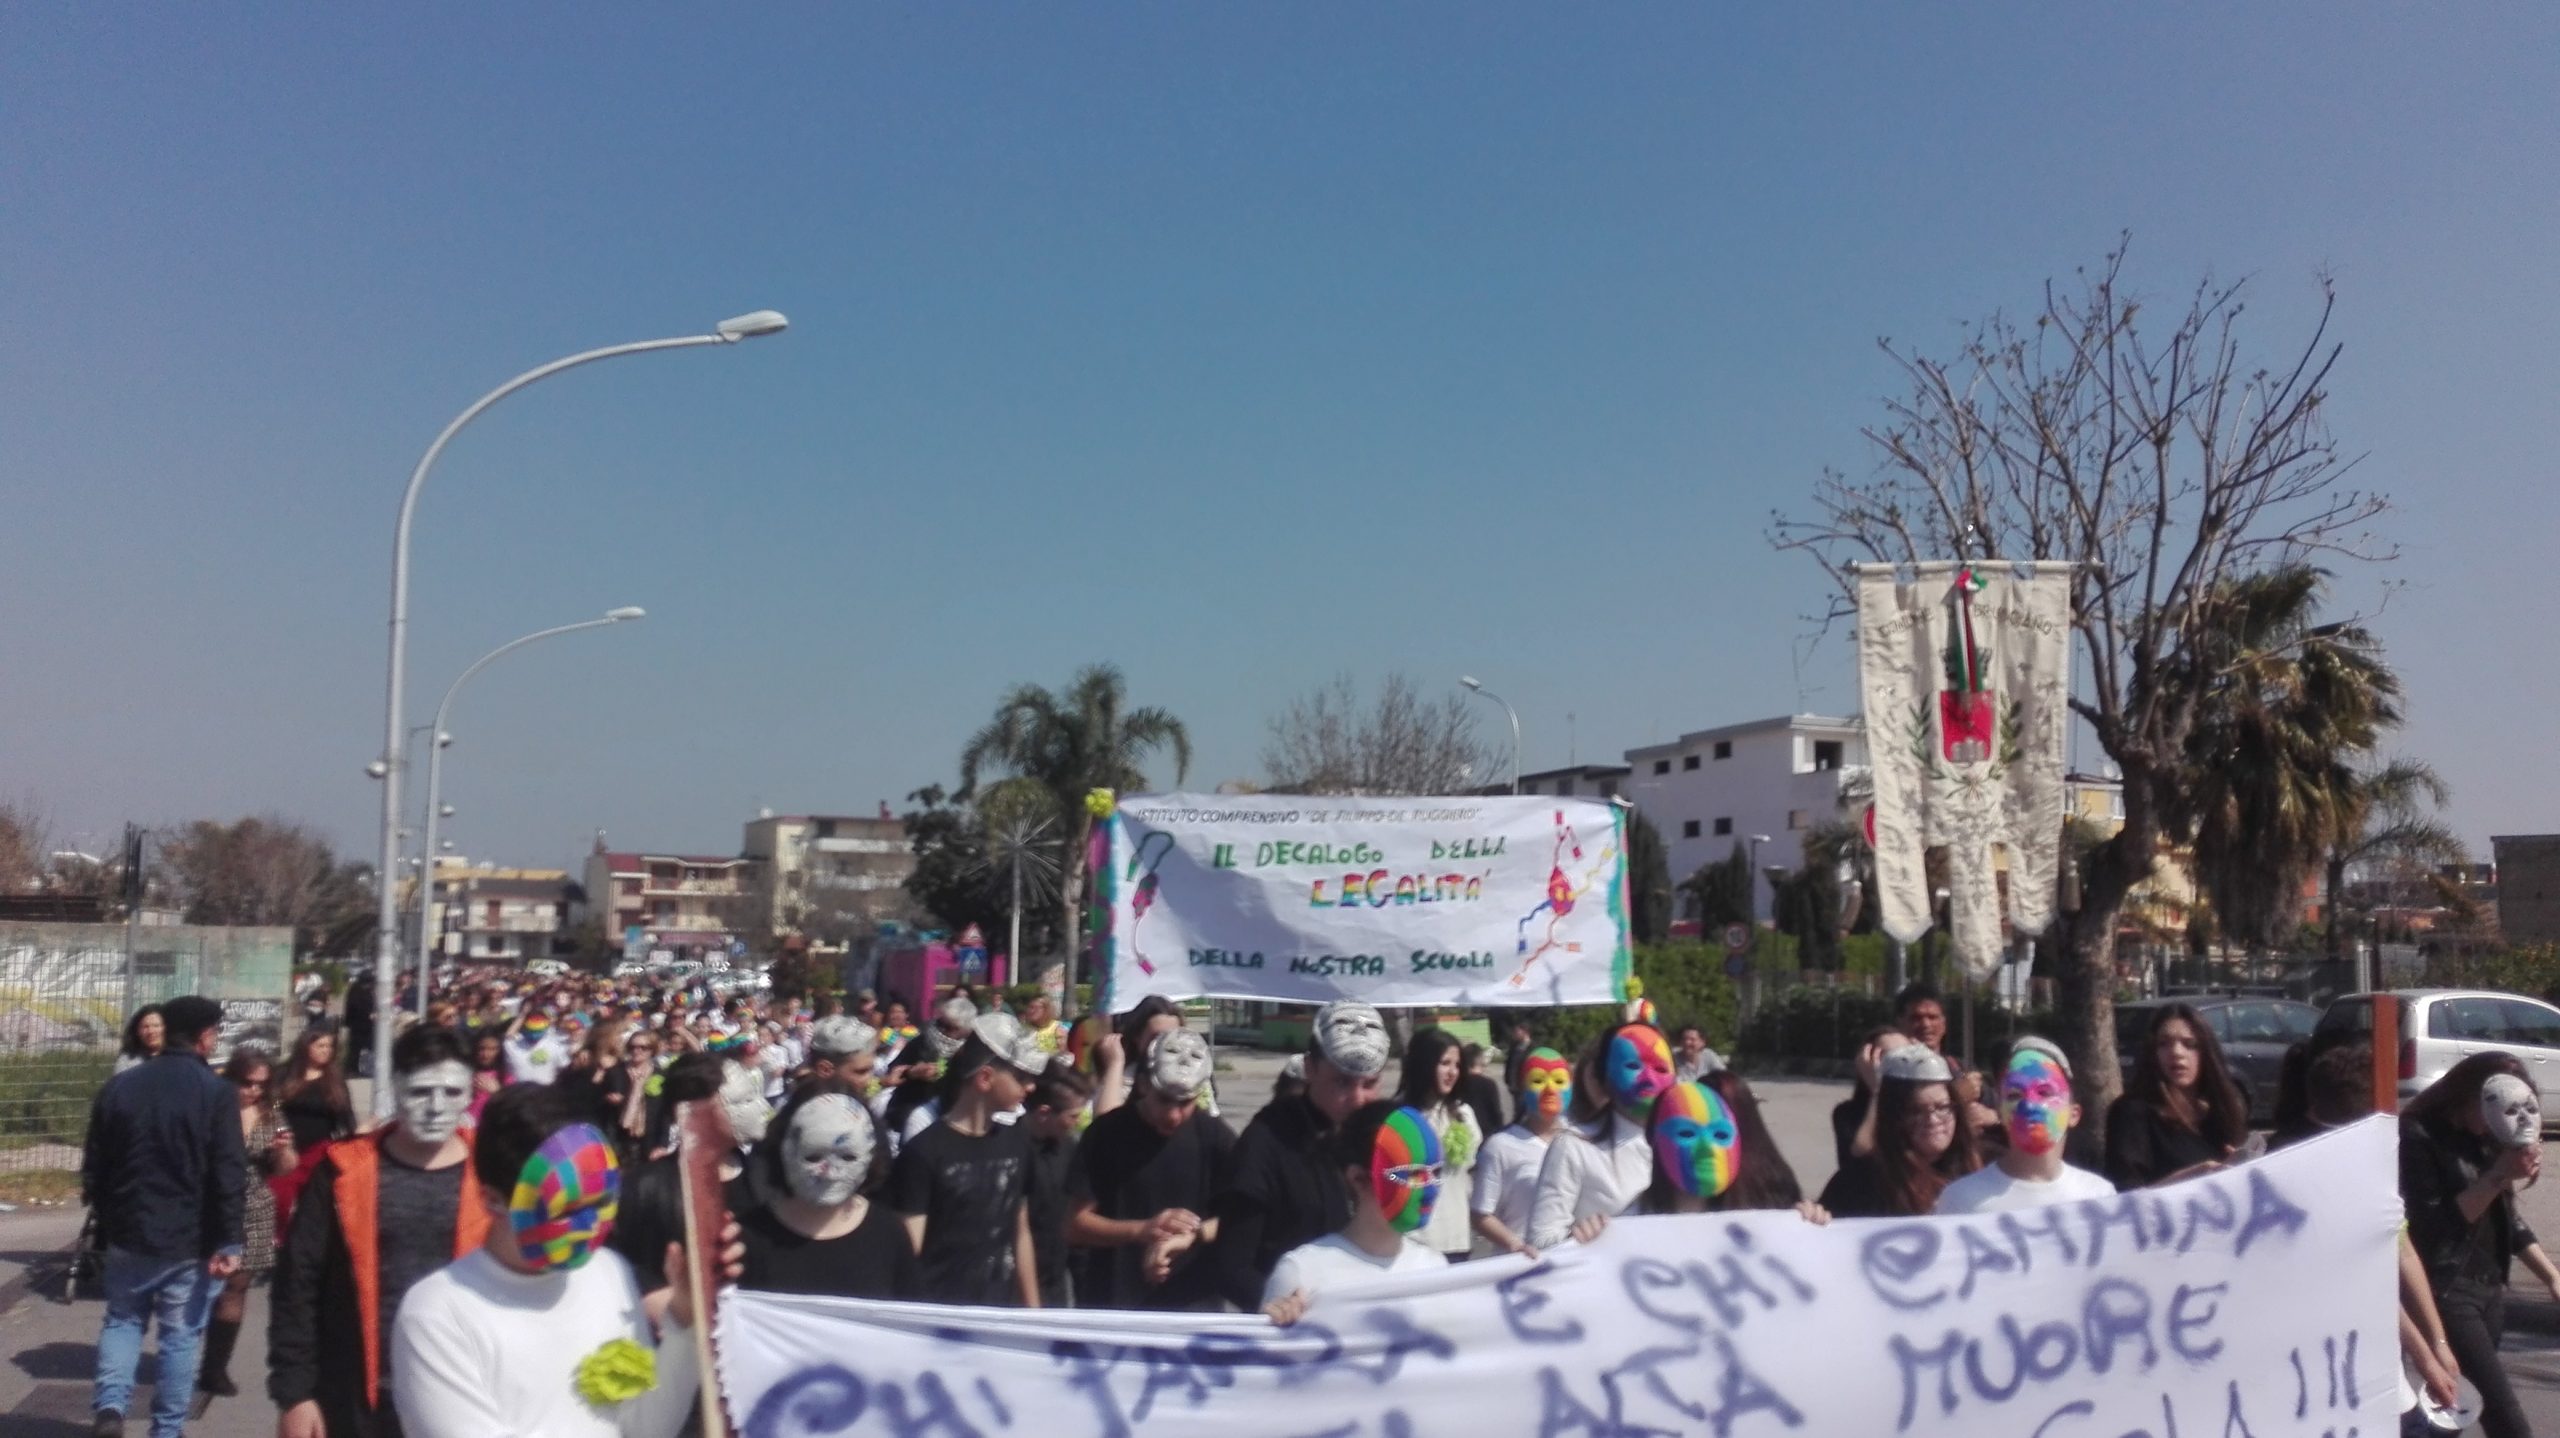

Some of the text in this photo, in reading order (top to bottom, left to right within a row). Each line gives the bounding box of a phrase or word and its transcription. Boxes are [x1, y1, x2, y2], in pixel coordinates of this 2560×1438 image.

[1136, 807, 1199, 823] ISTITUTO
[1200, 808, 1300, 825] COMPRENSIVO
[1213, 843, 1237, 868] IL
[1430, 834, 1507, 861] DELLA
[1189, 948, 1495, 977] DELLA NOSTRA SCUOLA
[1496, 1260, 1586, 1343] E
[1619, 1222, 1818, 1329] CHI
[1861, 1167, 2309, 1310] CAMMINA
[1888, 1275, 2230, 1434] MUORE
